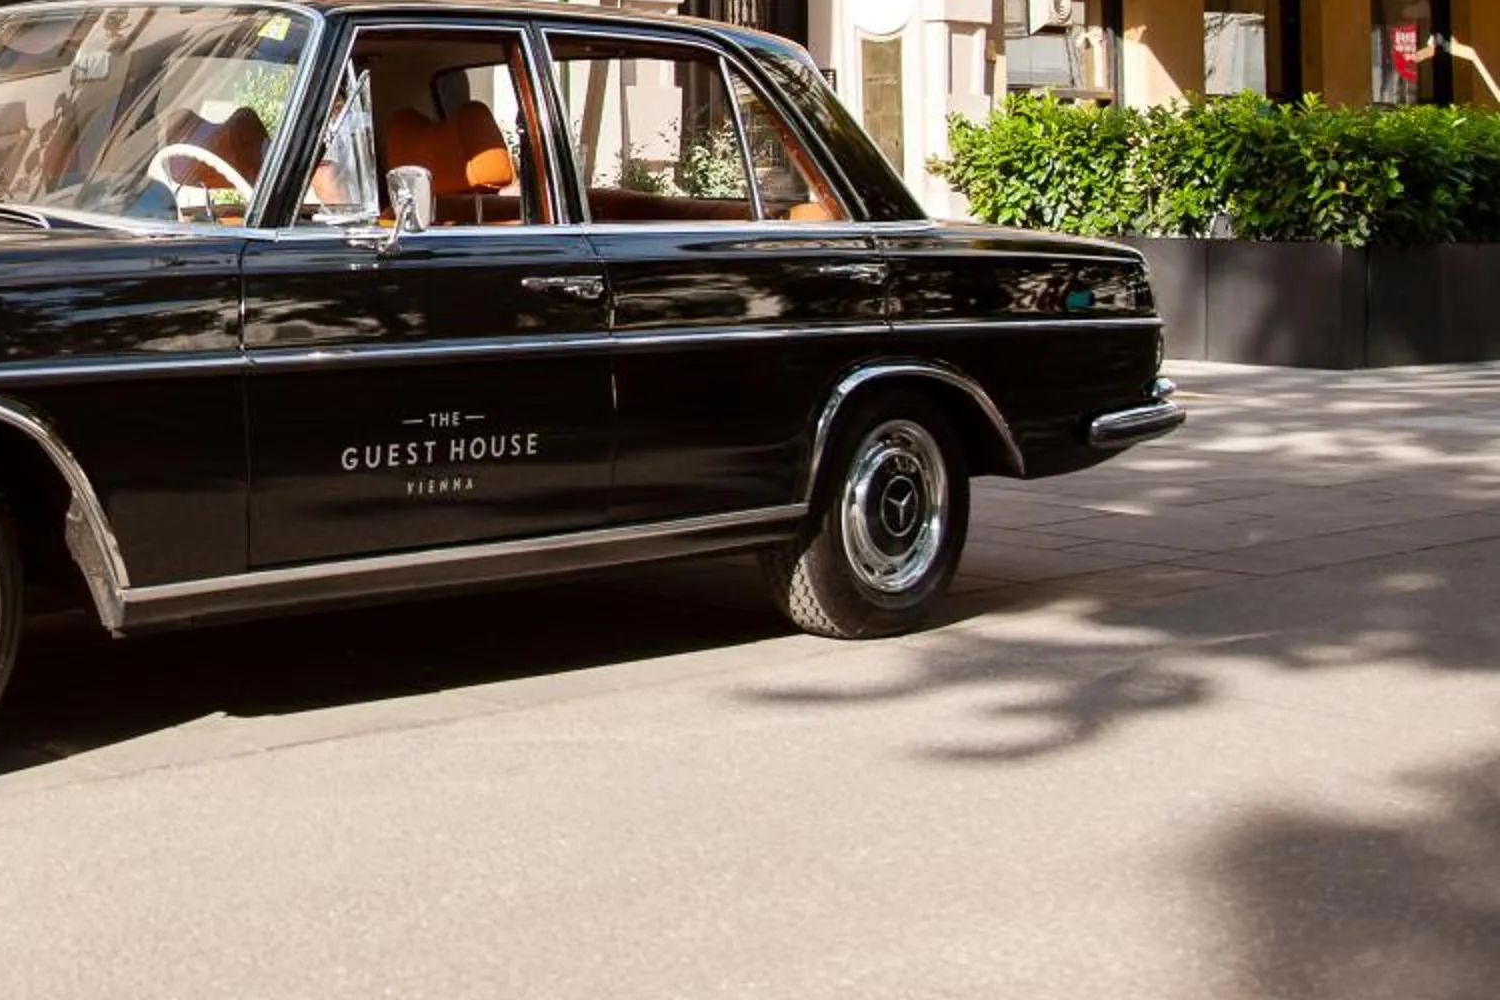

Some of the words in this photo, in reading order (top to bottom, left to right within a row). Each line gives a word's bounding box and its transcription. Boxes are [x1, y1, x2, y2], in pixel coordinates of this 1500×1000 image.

[429, 411, 461, 428] THE
[341, 442, 436, 470] GUEST
[450, 433, 538, 461] HOUSE
[407, 477, 474, 495] VIENNA
